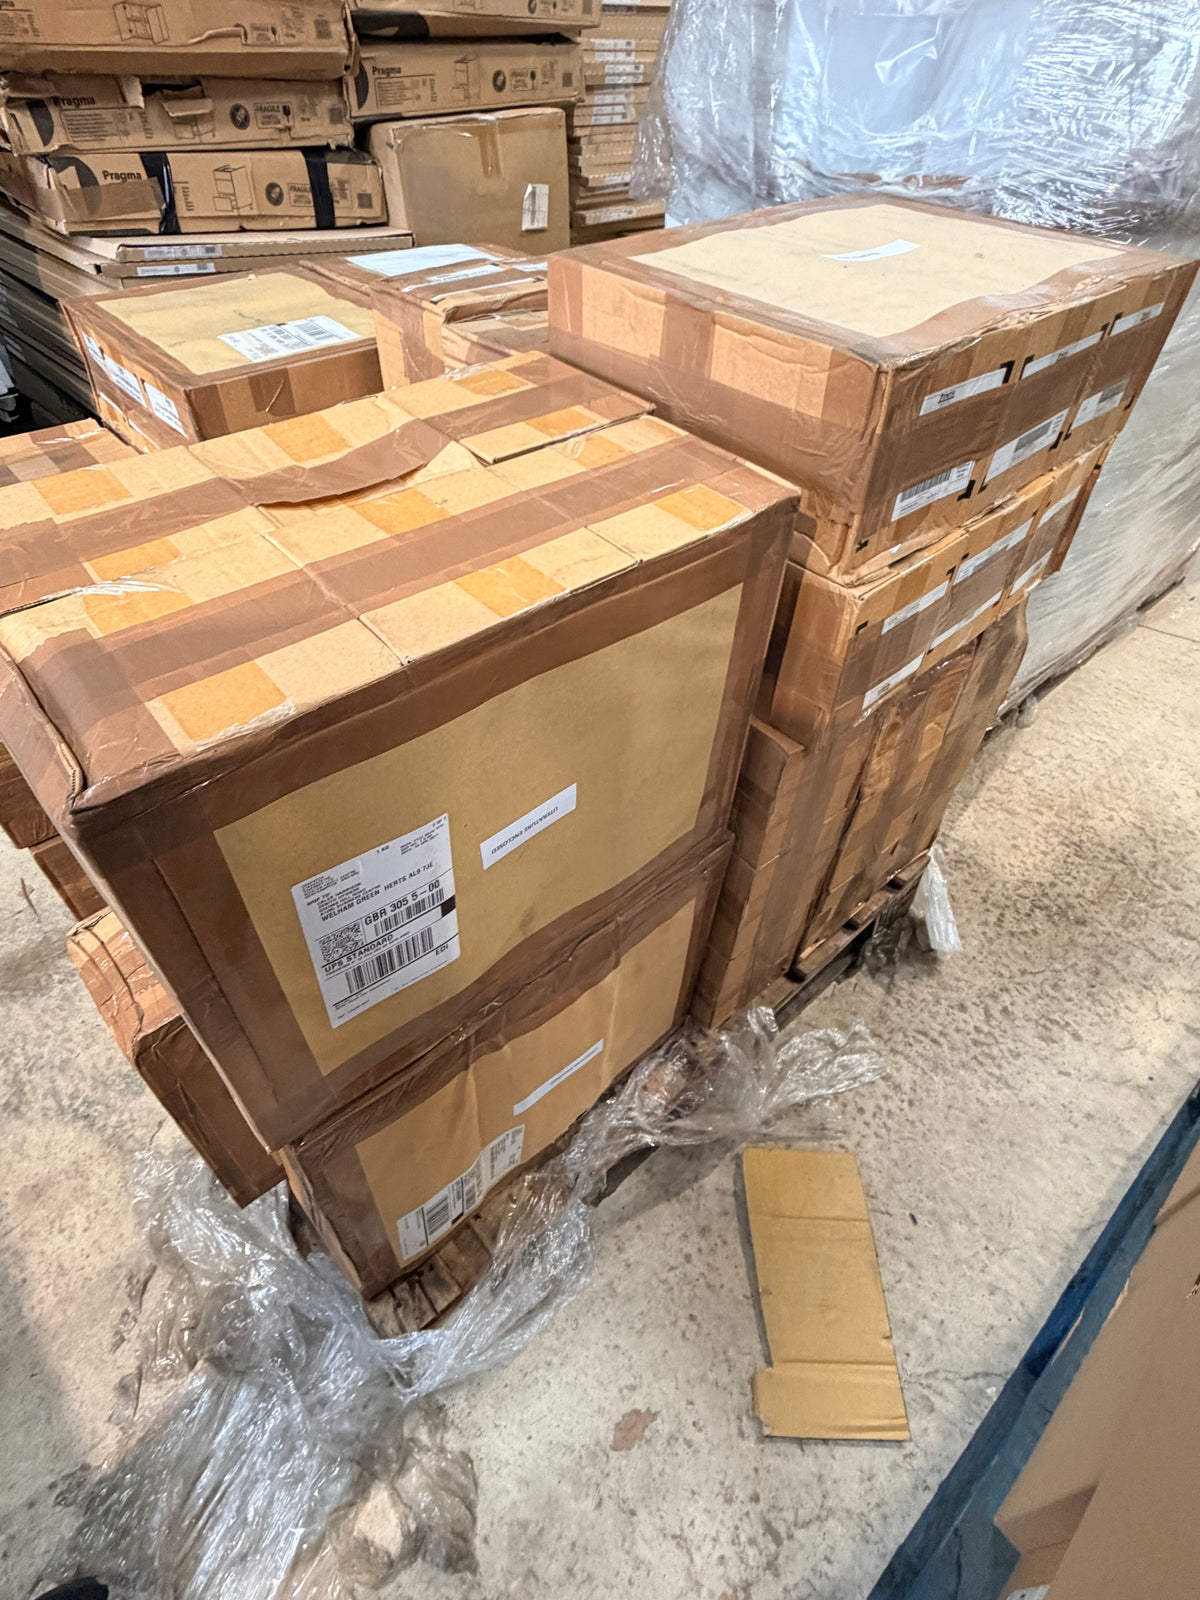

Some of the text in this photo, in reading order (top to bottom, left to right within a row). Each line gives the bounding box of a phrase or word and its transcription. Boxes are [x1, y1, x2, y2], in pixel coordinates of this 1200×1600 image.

[371, 65, 402, 77] Pragma
[51, 96, 96, 108] Pragma
[101, 170, 142, 182] Pragma
[491, 806, 559, 855] LITERATURE ENCLOSED
[321, 860, 432, 922] WELHAM GREEN HERTS AL9 7JE
[363, 907, 387, 926] GBR
[389, 895, 408, 912] 305
[324, 959, 343, 974] UPS
[345, 932, 393, 963] STANDARD
[435, 943, 448, 956] EDI
